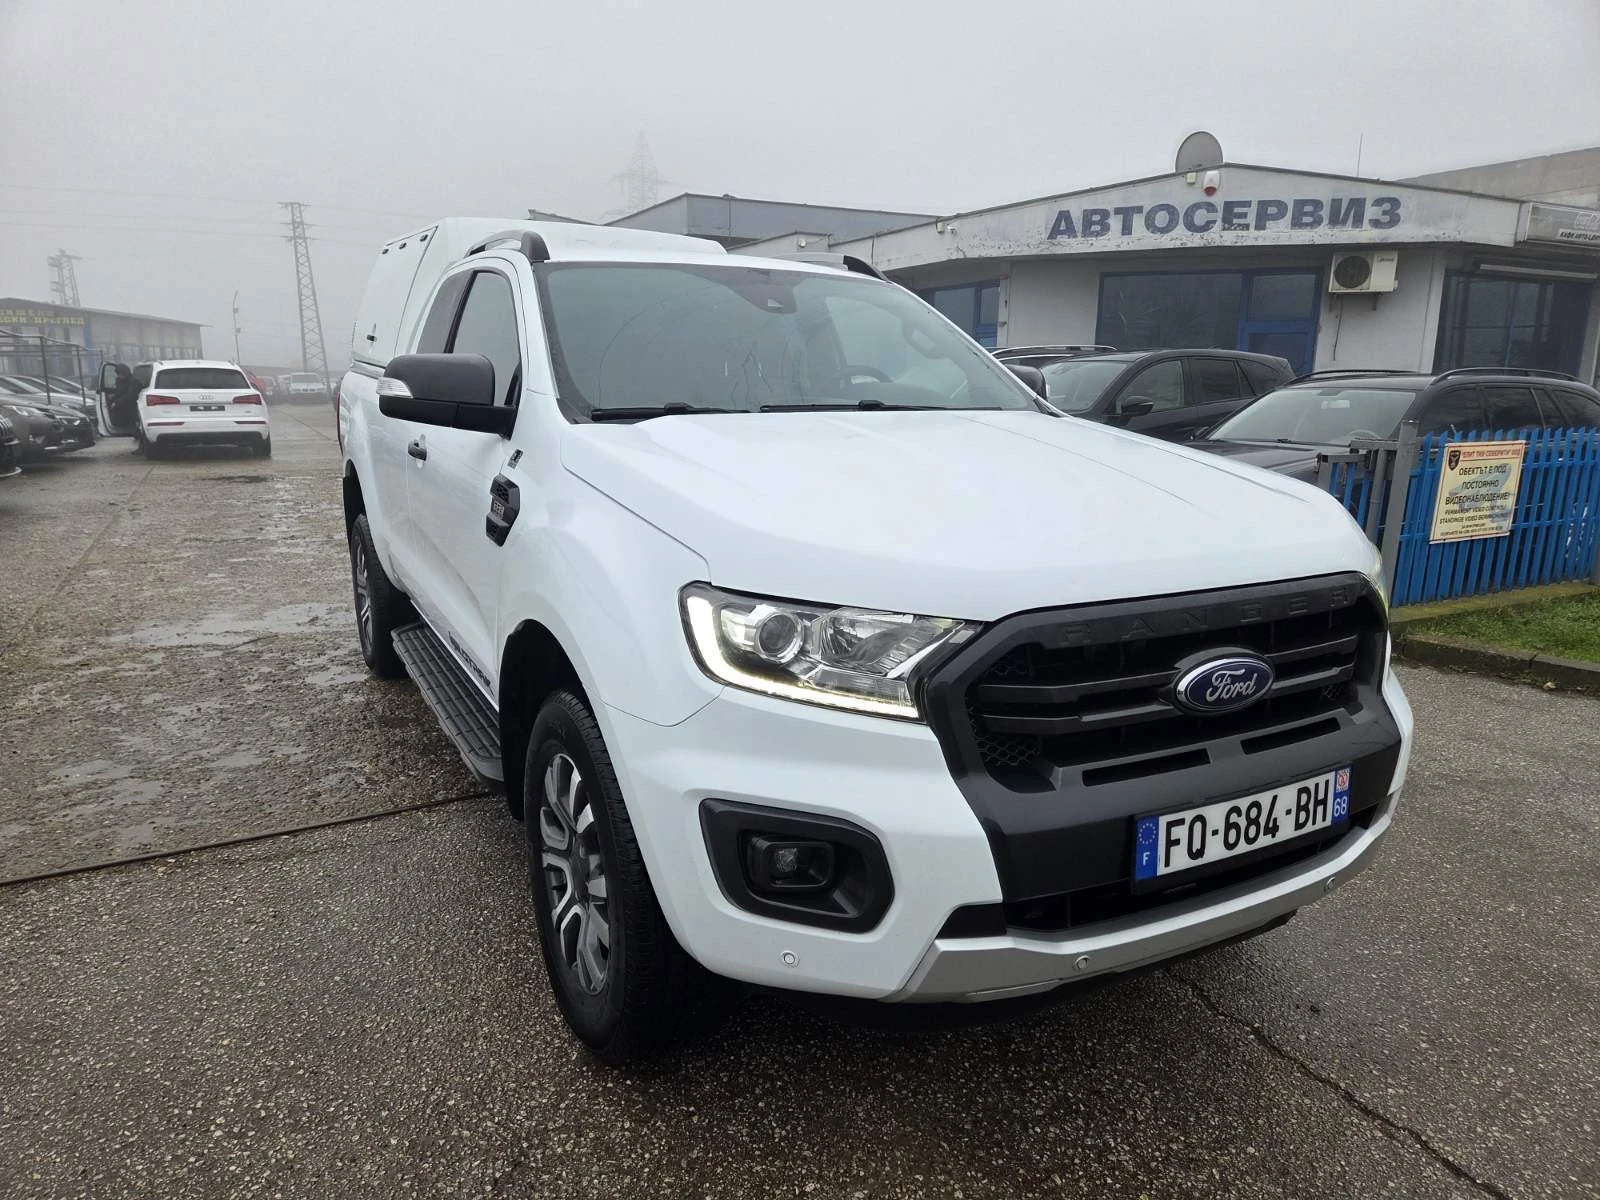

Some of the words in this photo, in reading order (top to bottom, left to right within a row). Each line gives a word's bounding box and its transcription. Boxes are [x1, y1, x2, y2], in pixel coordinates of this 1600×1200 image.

[1046, 196, 1403, 241] АВТОСЕРВИЗ
[1459, 466, 1488, 476] ОБЕКТЪТ
[1488, 466, 1493, 474] Е
[1493, 465, 1507, 474] ПОД
[1462, 479, 1500, 490] ПОСТОЯННО
[1061, 590, 1350, 646] RANGER
[1205, 668, 1258, 702] Ford
[1142, 851, 1151, 866] F
[1164, 779, 1330, 868] FQ-684-BH
[1333, 795, 1348, 818] 68
